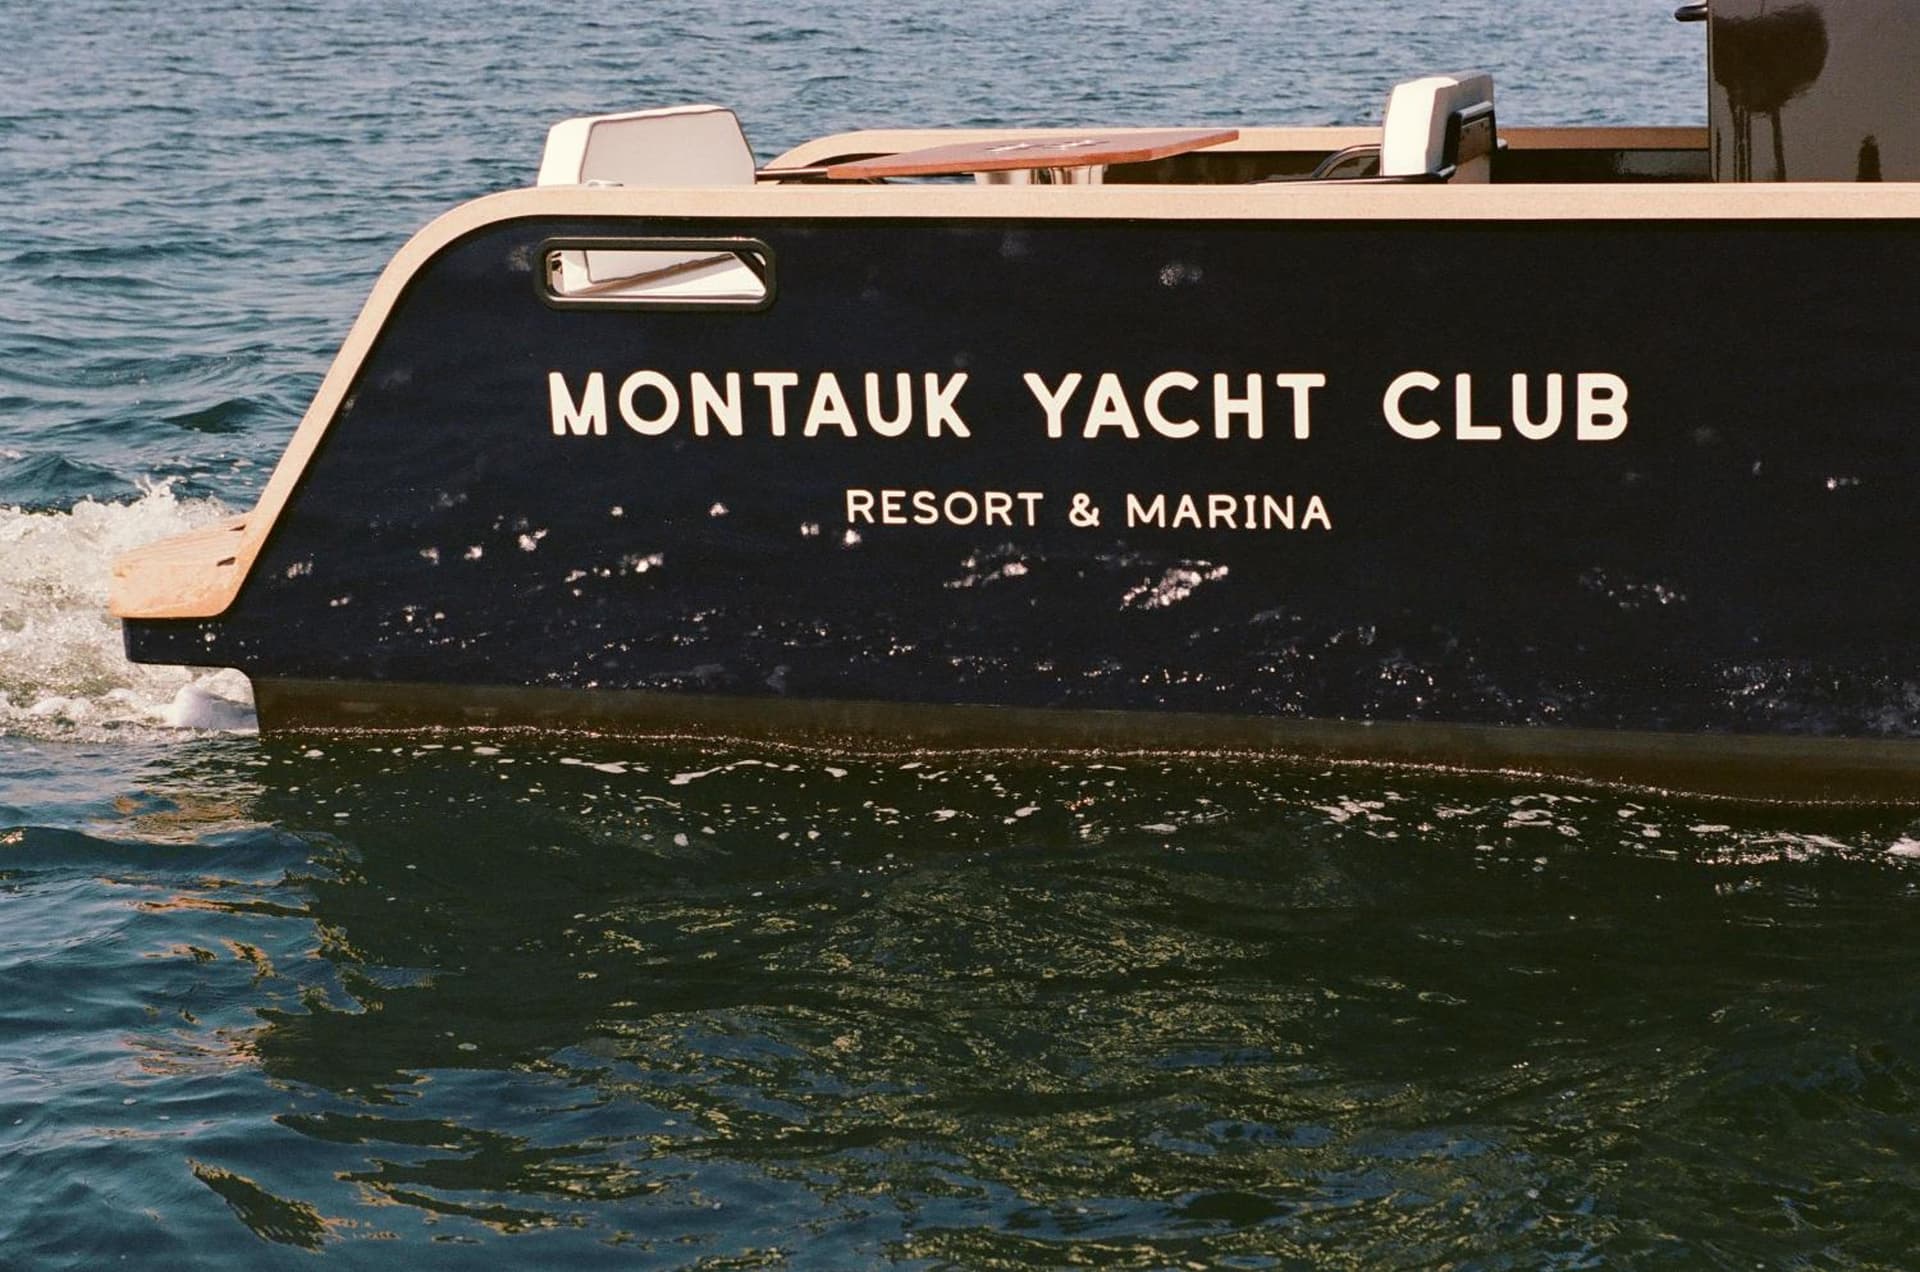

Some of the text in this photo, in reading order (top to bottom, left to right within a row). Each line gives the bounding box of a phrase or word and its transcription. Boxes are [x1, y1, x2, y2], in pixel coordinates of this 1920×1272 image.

[548, 370, 1628, 441] MONTAUK YACHT CLUB
[846, 489, 1332, 530] RESORT & MARINA
